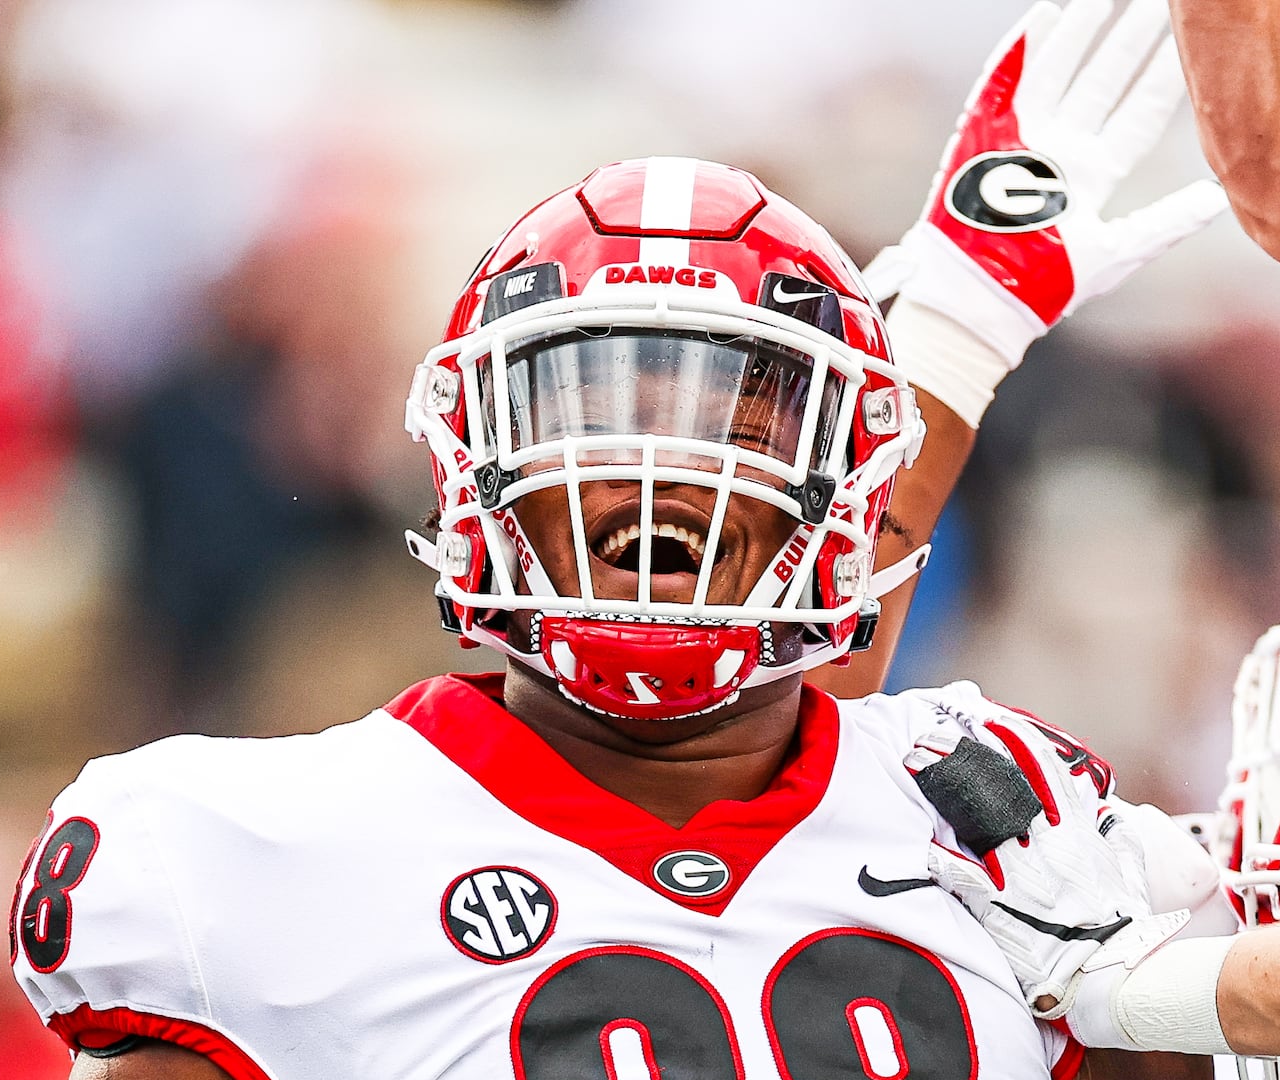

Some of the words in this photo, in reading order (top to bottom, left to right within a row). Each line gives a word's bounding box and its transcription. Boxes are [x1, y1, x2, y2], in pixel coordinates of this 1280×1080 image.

[951, 155, 1069, 227] G
[503, 271, 538, 299] NIKE
[605, 265, 717, 289] DAWGS
[8, 808, 101, 974] 8
[656, 854, 726, 893] G
[449, 870, 550, 957] SEC
